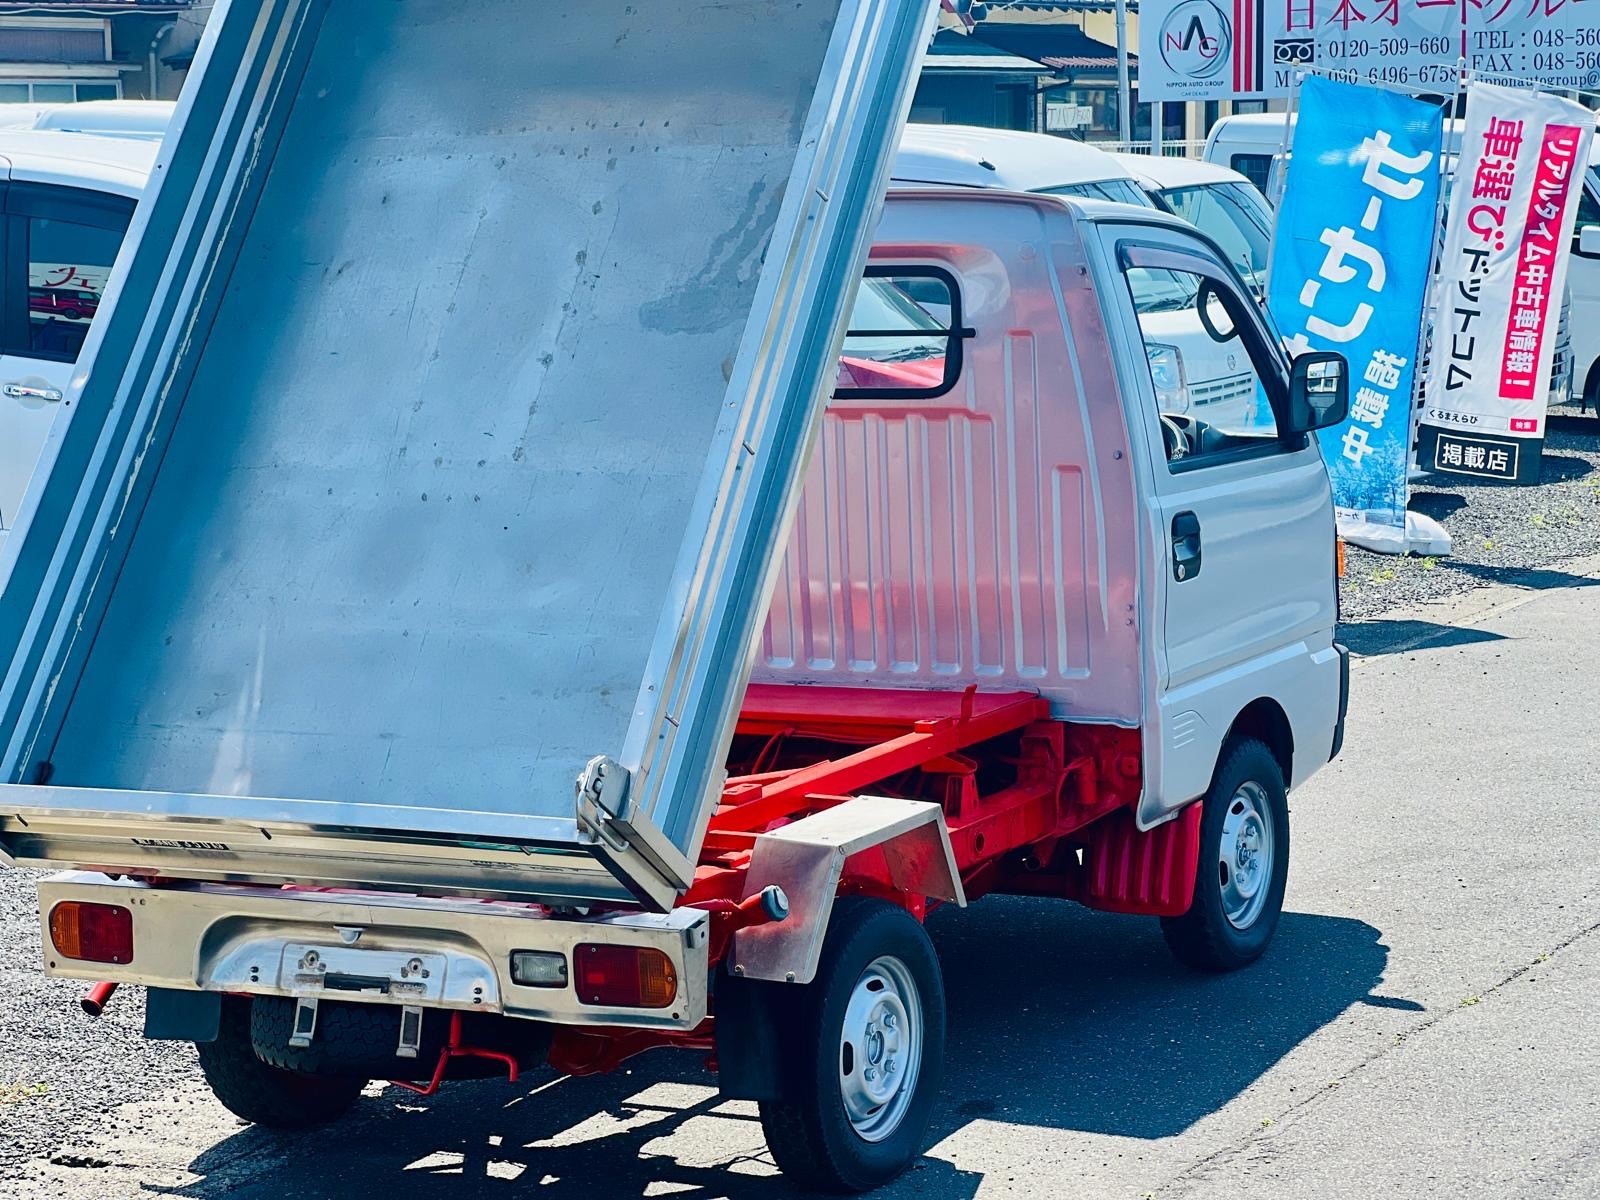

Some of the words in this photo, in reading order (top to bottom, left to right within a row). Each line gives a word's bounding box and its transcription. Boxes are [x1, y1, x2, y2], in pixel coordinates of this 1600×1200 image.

[1329, 36, 1450, 58] 0120-509-660
[1475, 71, 1600, 88] ipponautogroup@
[1429, 409, 1478, 424] くるまえらび
[1441, 442, 1509, 472] 掲載店
